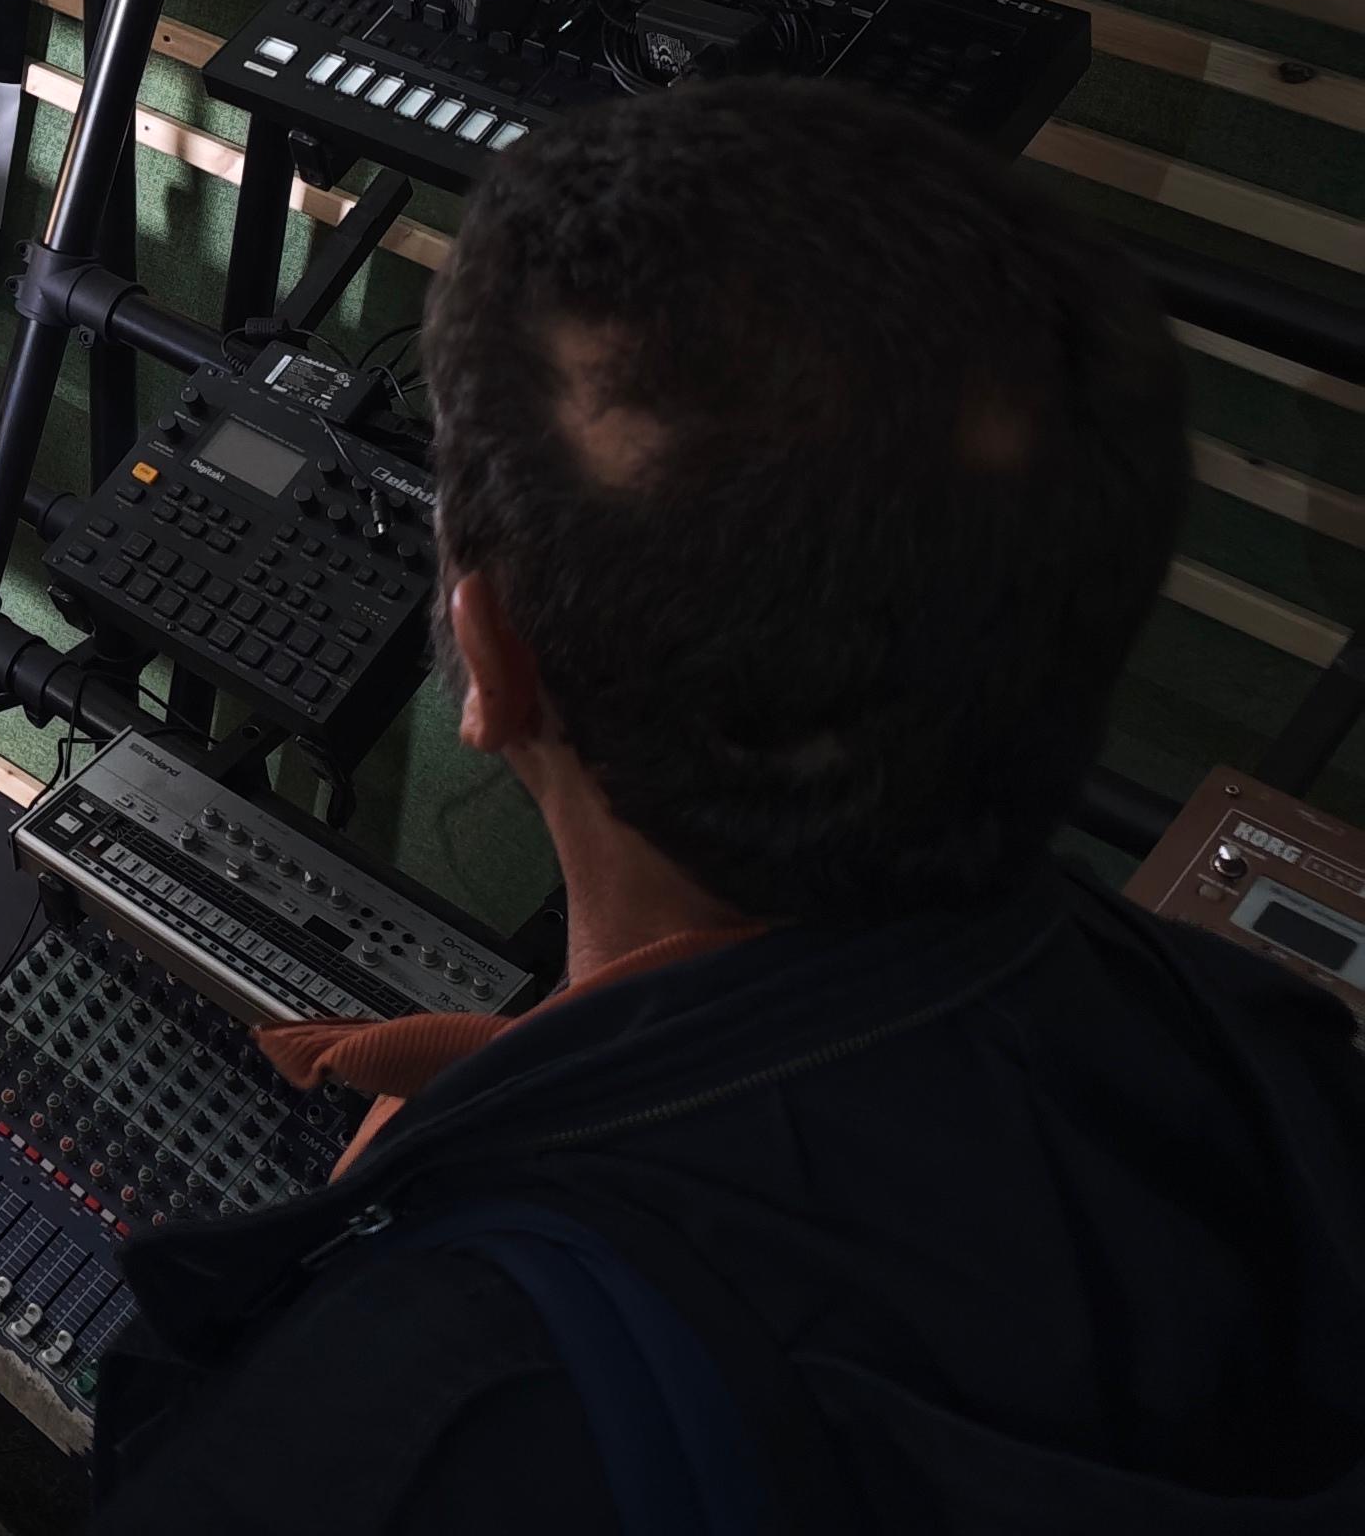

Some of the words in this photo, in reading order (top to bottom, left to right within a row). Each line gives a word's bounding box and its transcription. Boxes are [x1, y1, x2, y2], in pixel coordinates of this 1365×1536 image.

[190, 459, 226, 483] Digitakt
[142, 751, 181, 777] Roland
[1233, 821, 1303, 864] KORG
[442, 936, 506, 980] Drumatix
[438, 992, 471, 1012] TR-0
